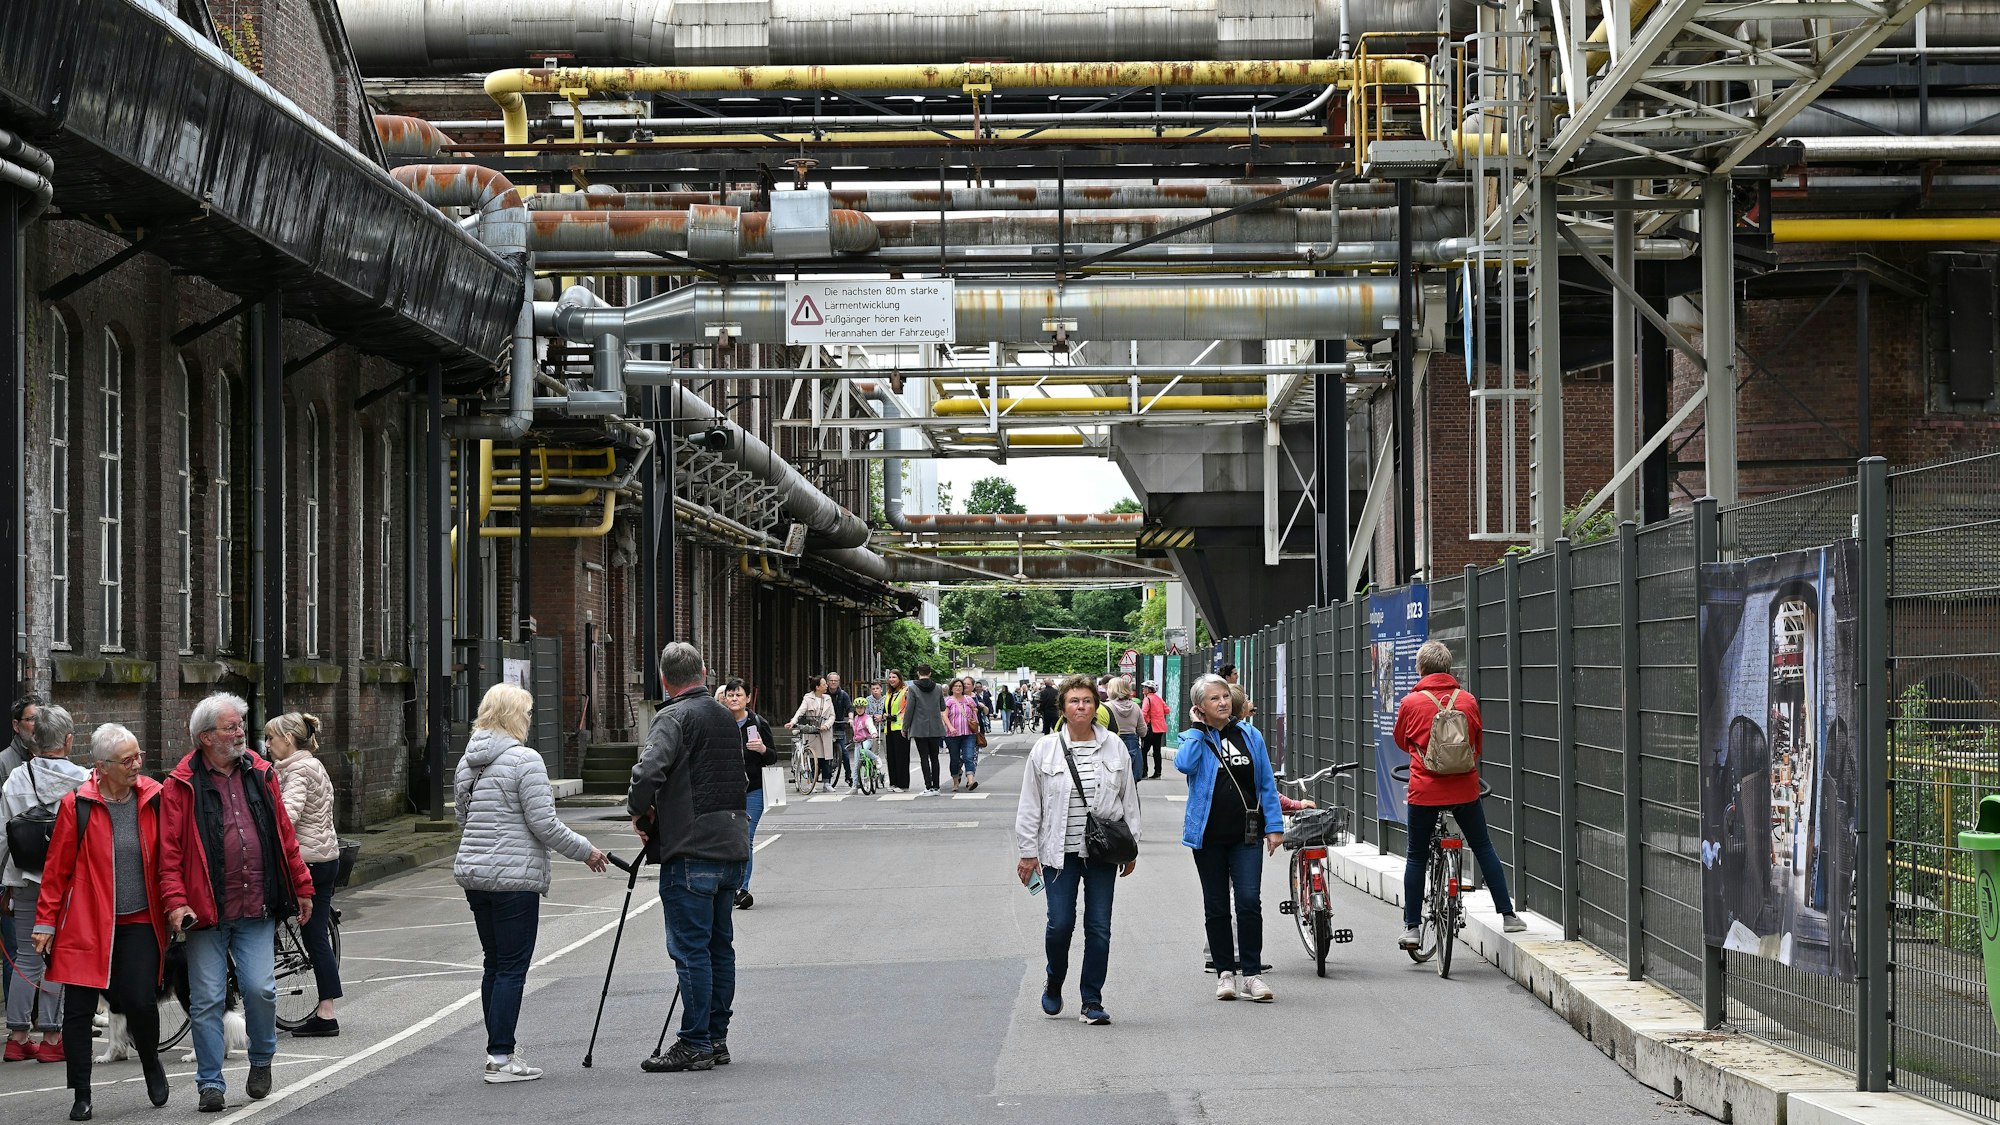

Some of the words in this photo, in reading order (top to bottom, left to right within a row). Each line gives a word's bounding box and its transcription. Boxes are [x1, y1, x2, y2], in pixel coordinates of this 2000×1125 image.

[824, 287, 839, 296] Die
[842, 286, 882, 296] nächsten
[910, 286, 939, 295] starke
[824, 301, 900, 311] Lärmentwicklung
[824, 315, 870, 325] Fußgänger
[874, 314, 900, 323] hören
[903, 314, 922, 323] kein
[825, 329, 877, 337] Herannahen
[881, 328, 896, 337] der
[899, 327, 949, 338] Fahrzeuge!
